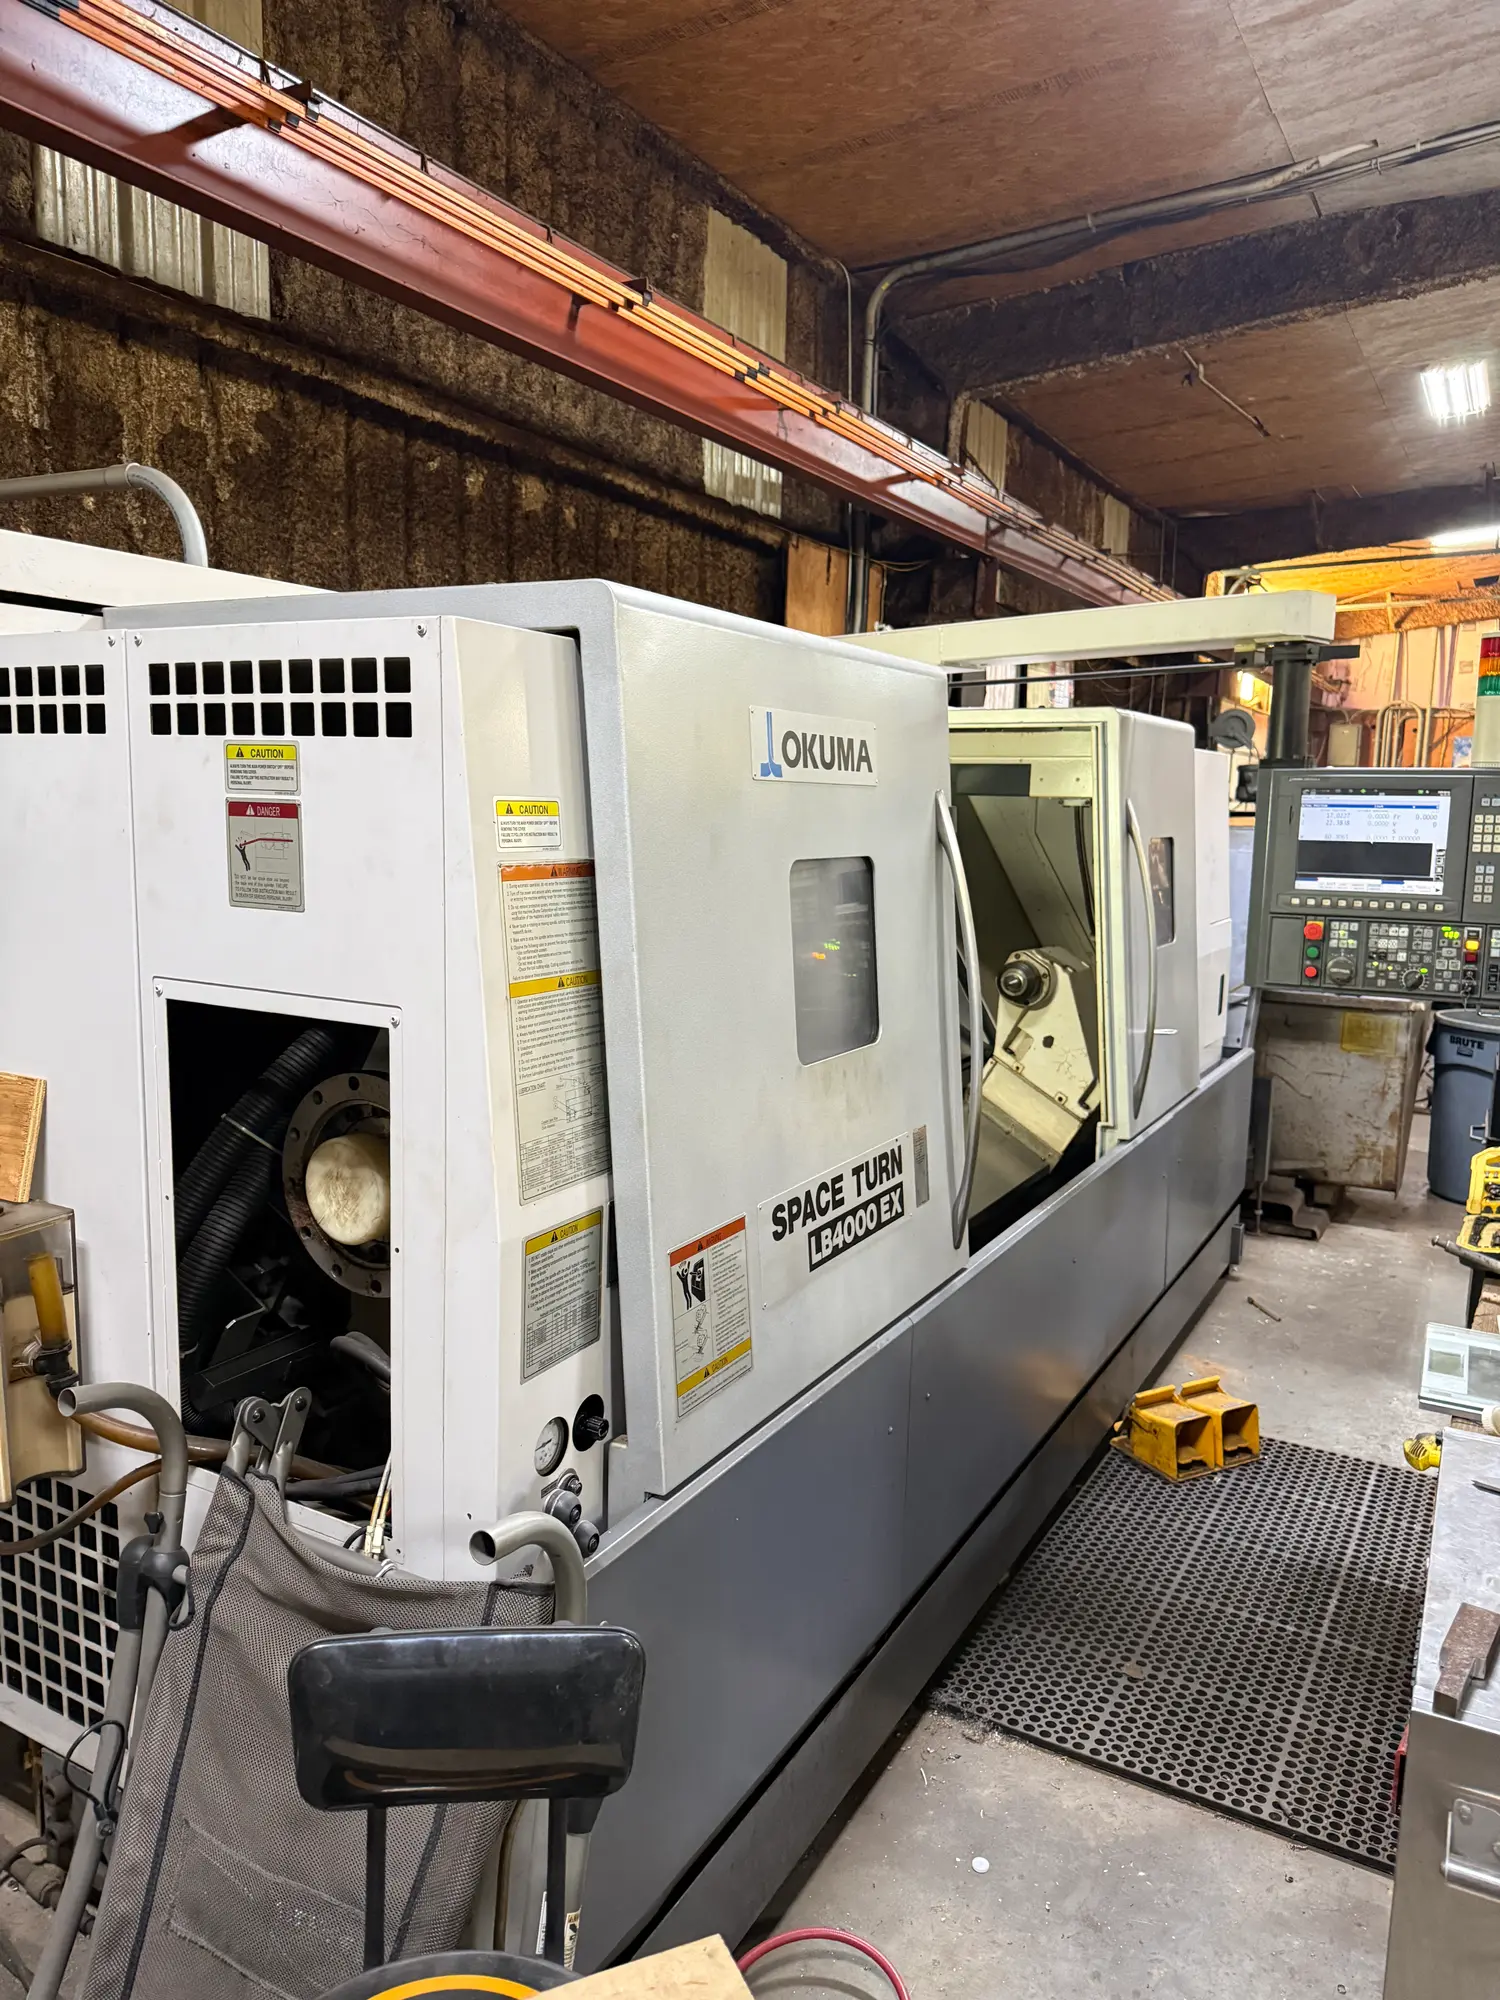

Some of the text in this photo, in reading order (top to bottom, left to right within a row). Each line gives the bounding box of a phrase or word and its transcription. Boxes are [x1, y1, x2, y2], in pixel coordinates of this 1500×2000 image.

[250, 748, 284, 759] CAUTION
[781, 730, 873, 773] OKUMA
[256, 805, 281, 817] DANGER
[519, 804, 549, 815] CAUTION
[1449, 1034, 1485, 1050] BRUTE
[771, 1173, 845, 1242] SPACE
[851, 1144, 903, 1198] TURN
[560, 1223, 579, 1239] CAUTION
[809, 1187, 903, 1266] LB4000 EX
